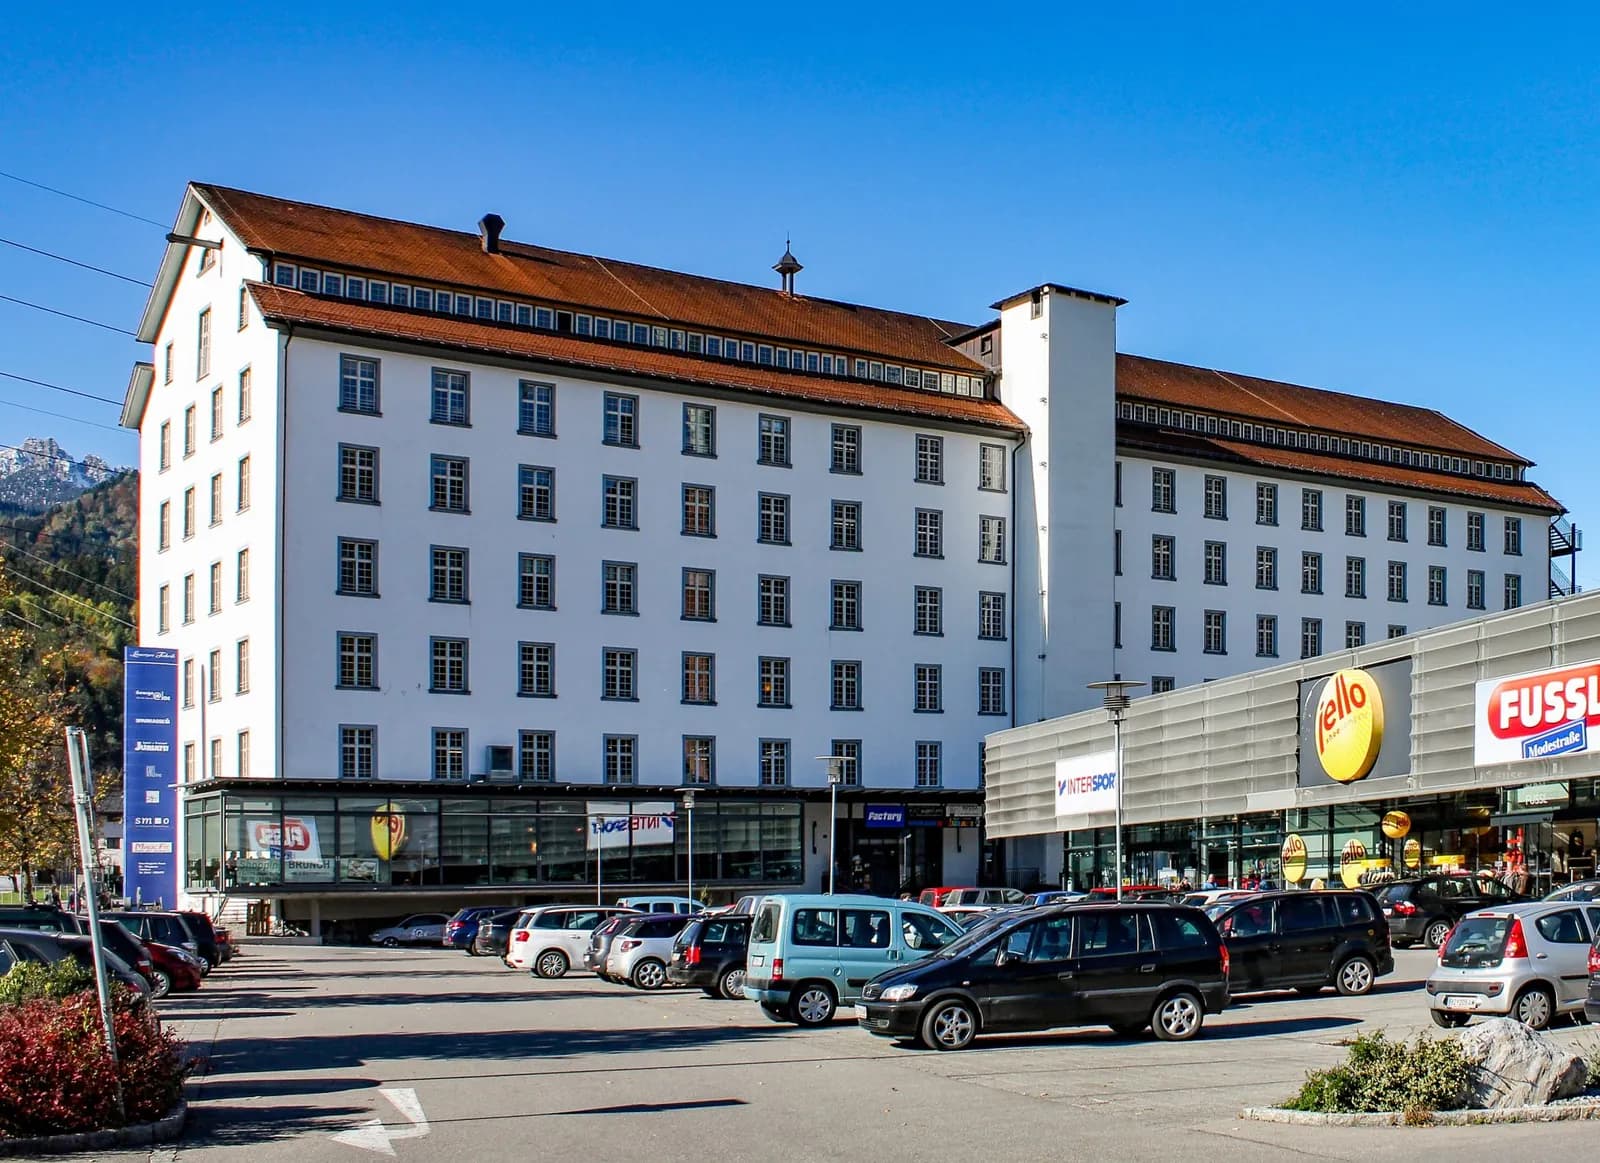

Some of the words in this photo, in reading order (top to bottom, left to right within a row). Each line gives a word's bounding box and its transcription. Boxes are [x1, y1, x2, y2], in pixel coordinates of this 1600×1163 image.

[1318, 673, 1367, 755] jello
[1499, 675, 1600, 729] FUSSL
[1528, 730, 1581, 758] Modestraße
[867, 811, 902, 823] Factory
[288, 860, 330, 870] BRUNCH
